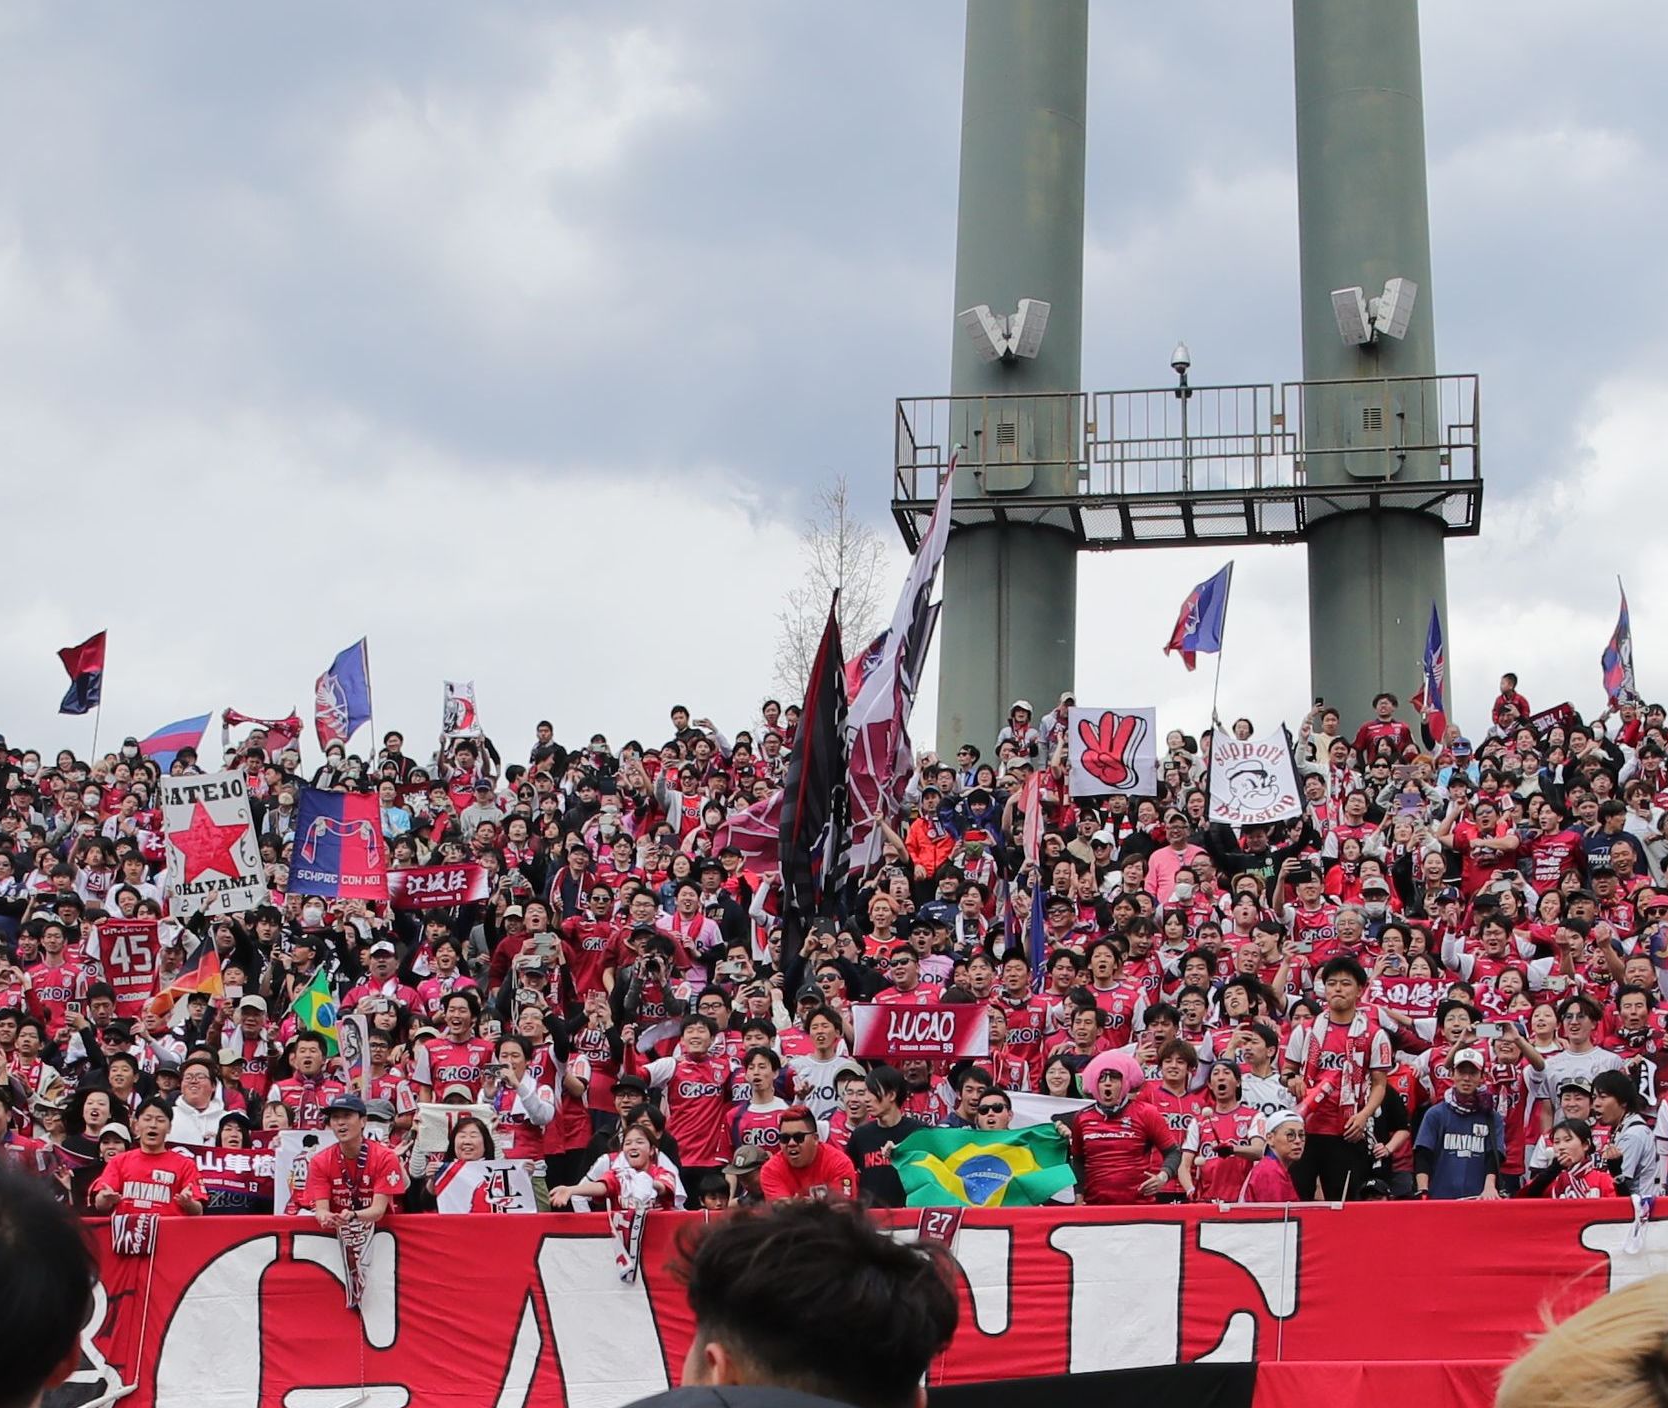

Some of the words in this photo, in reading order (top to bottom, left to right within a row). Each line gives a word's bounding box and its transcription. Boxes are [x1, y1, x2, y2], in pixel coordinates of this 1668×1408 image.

[1214, 738, 1285, 768] support
[1213, 792, 1296, 822] nonstop
[175, 874, 260, 897] OKAYAMA
[109, 935, 152, 973] 45
[887, 1011, 955, 1042] LUCAO
[942, 1042, 954, 1053] 99
[437, 1067, 481, 1083] GROP
[926, 1211, 953, 1232] 27
